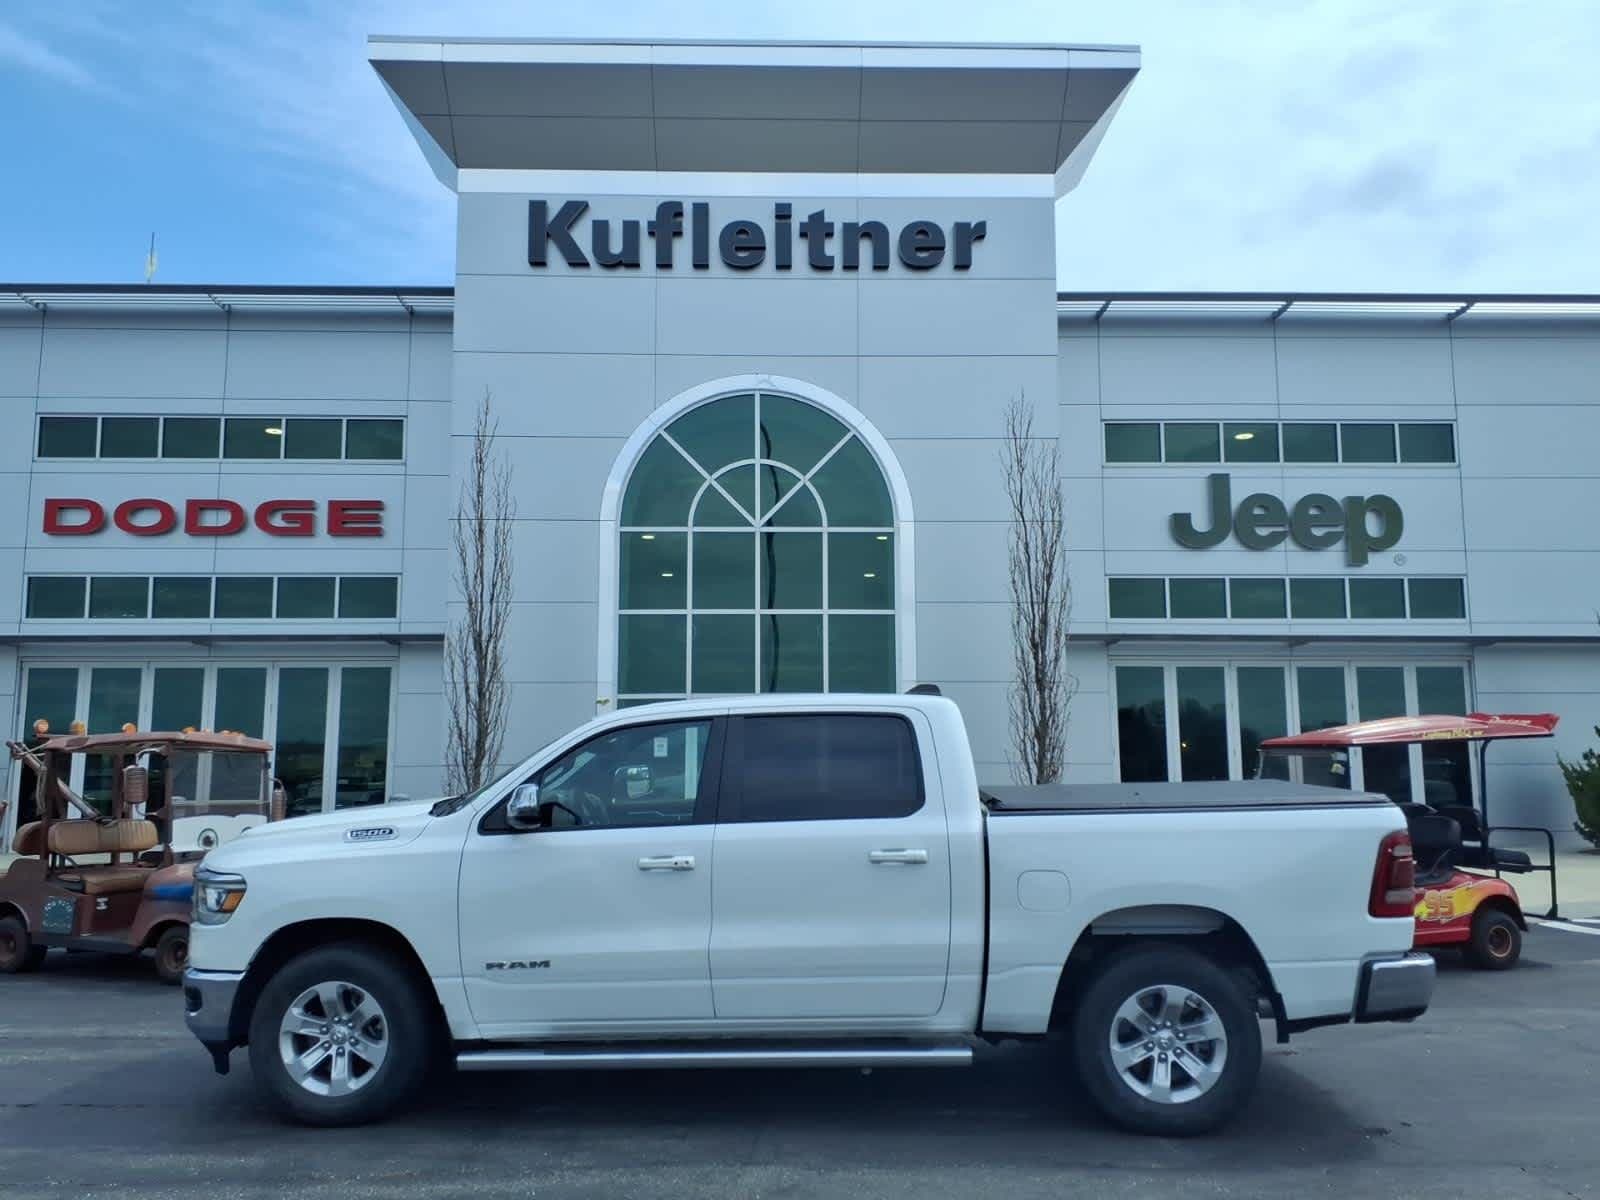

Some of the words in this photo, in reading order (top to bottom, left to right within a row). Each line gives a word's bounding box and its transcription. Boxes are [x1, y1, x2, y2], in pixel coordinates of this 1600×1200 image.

[527, 199, 988, 272] Kufleitner
[43, 497, 386, 537] DODGE
[1168, 473, 1404, 568] Jeep
[485, 959, 551, 971] RAM
